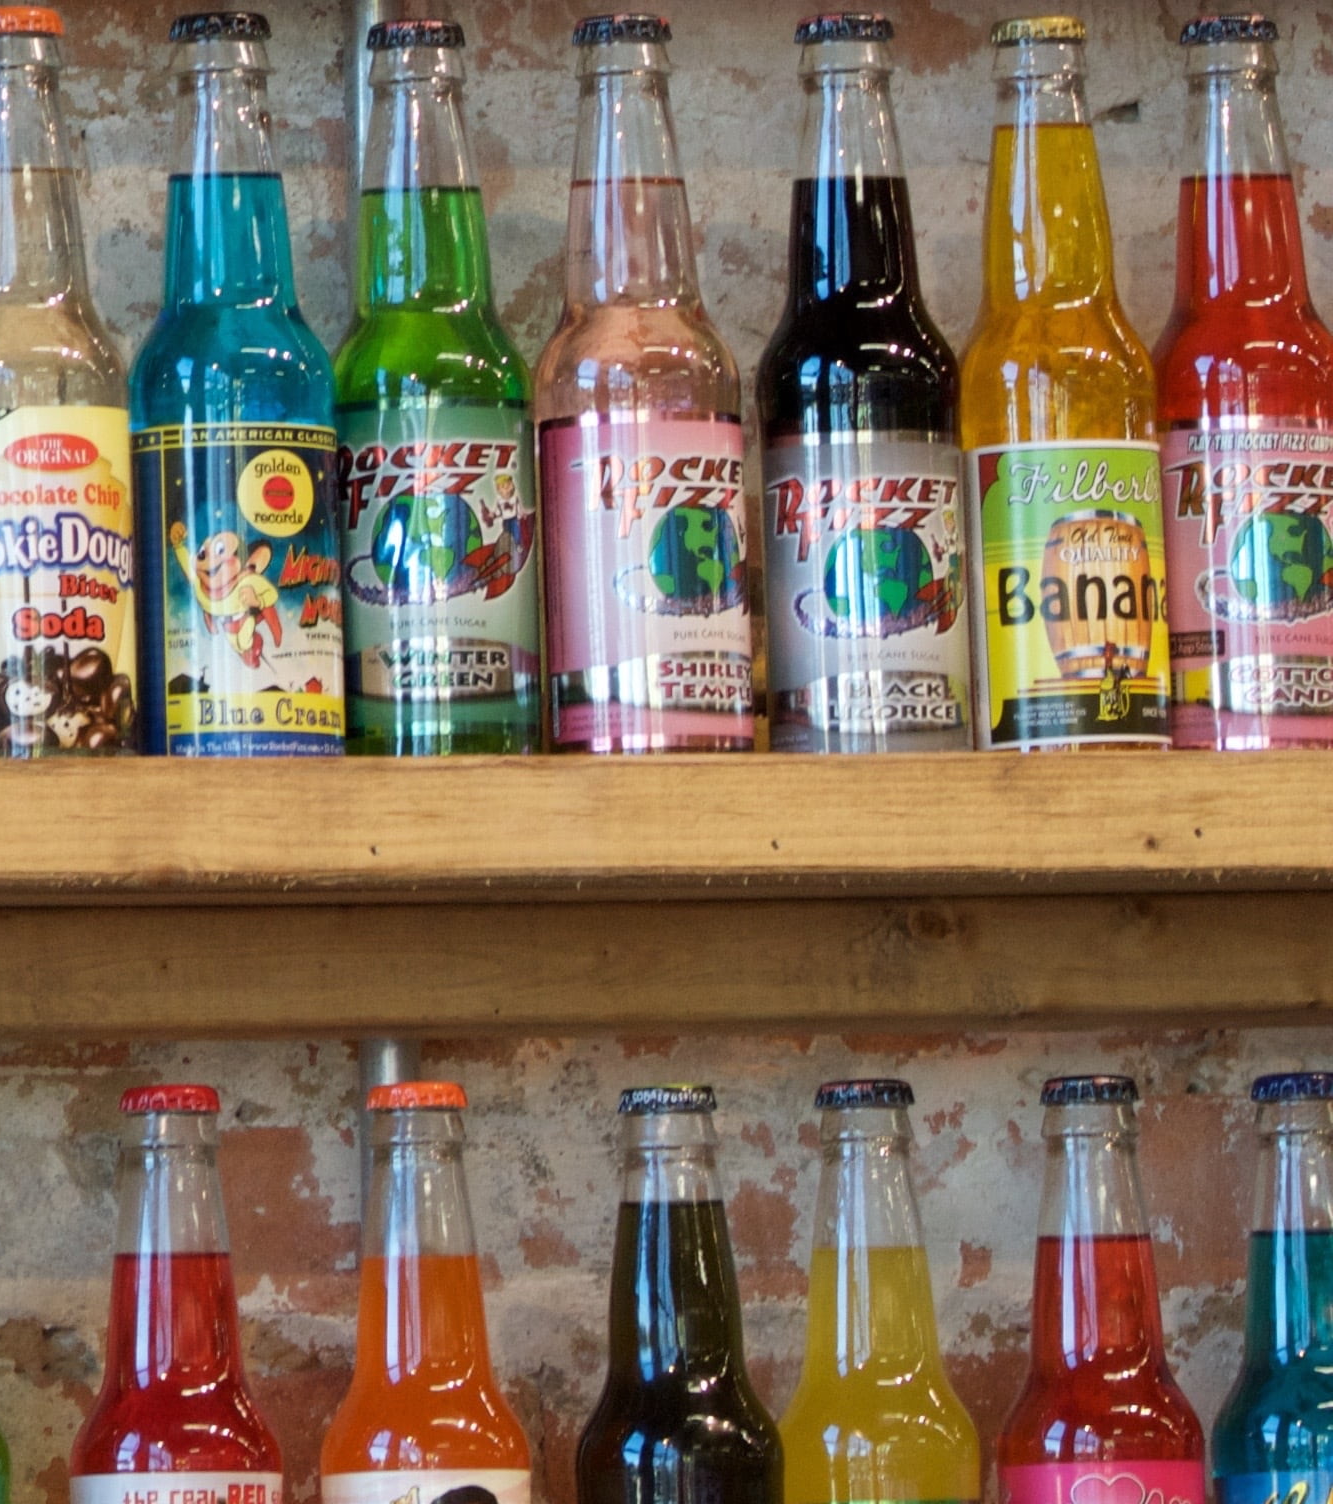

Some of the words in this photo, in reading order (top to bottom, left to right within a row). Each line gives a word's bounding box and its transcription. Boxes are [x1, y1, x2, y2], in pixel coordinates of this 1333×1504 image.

[84, 487, 121, 510] Chip
[199, 698, 267, 727] Blue
[828, 700, 956, 722] LICORICE
